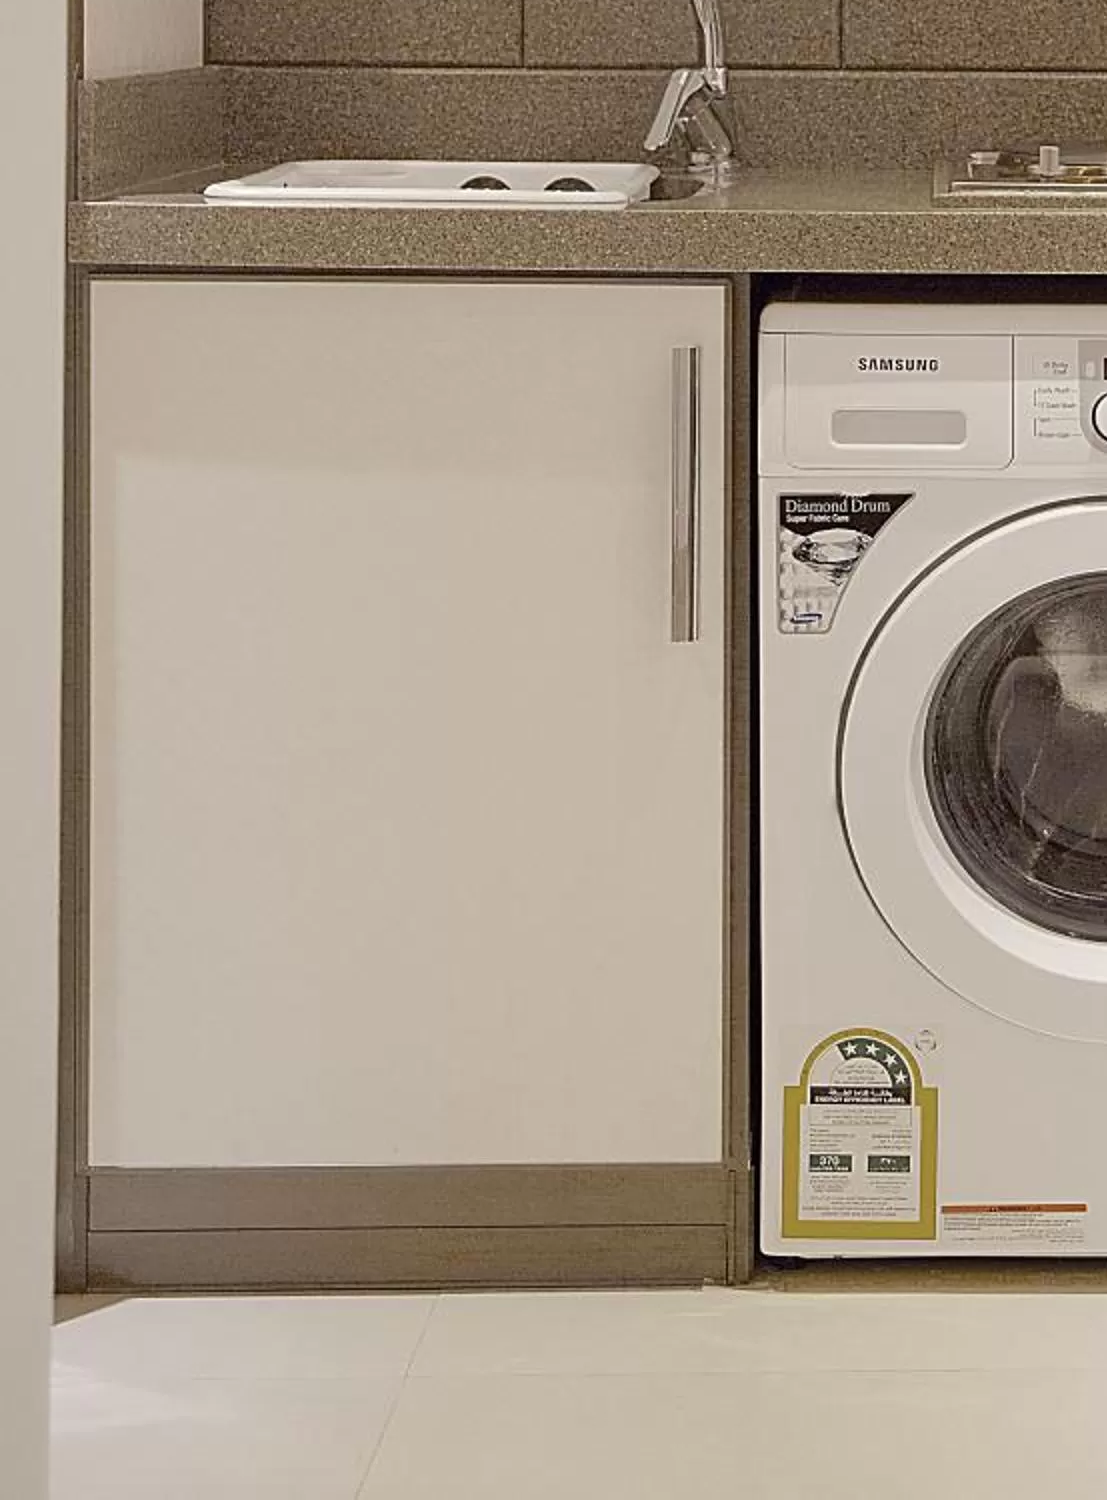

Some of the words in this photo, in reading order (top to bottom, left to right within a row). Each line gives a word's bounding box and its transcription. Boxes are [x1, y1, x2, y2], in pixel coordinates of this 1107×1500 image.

[857, 357, 940, 372] SAMSUNG
[785, 499, 848, 513] Diamond
[851, 499, 891, 513] Drum
[785, 514, 807, 524] Super
[808, 514, 831, 523] Fabric
